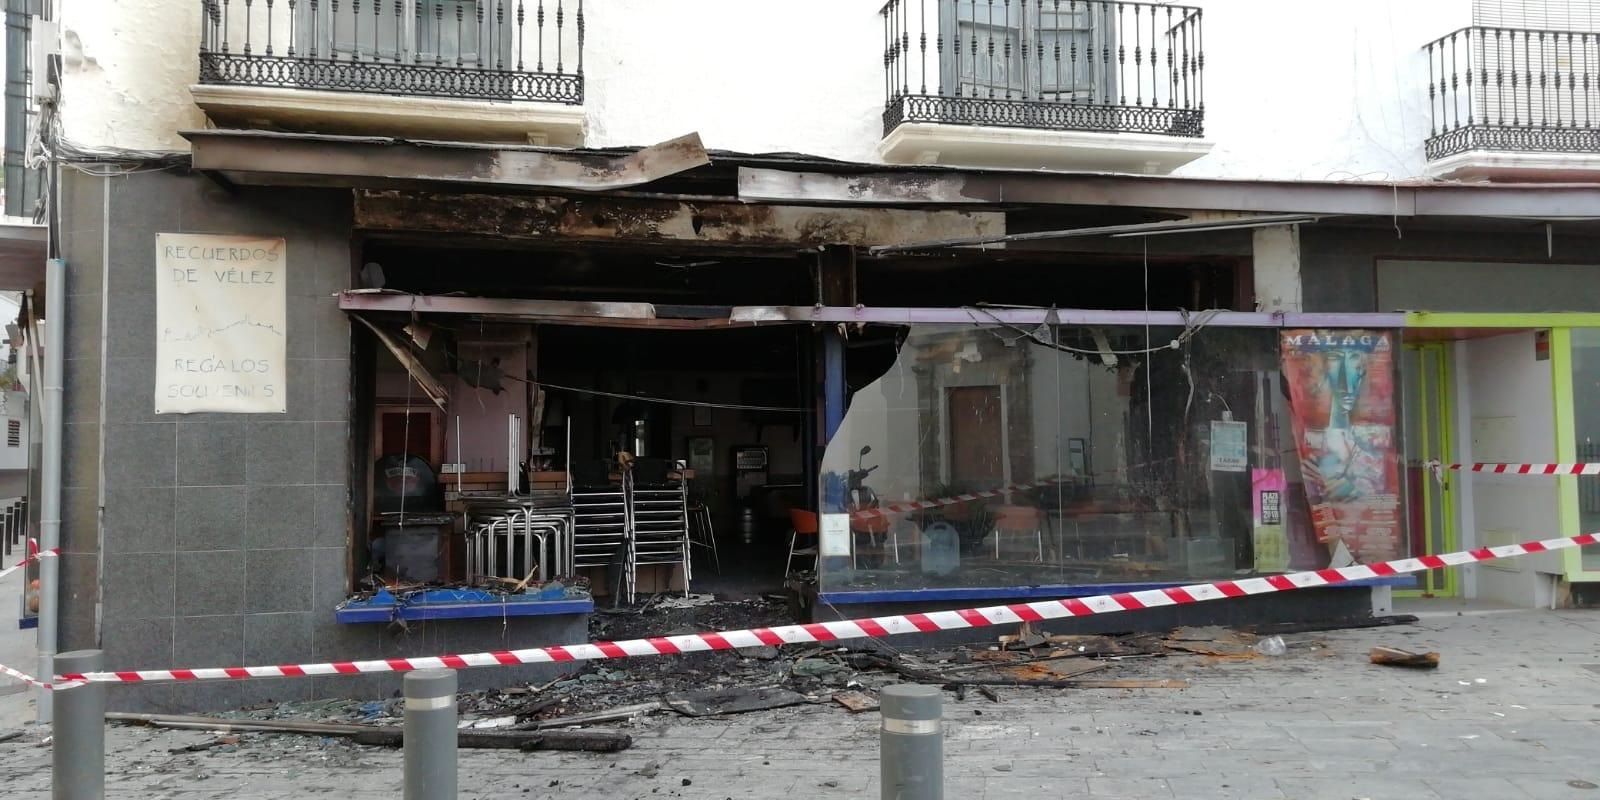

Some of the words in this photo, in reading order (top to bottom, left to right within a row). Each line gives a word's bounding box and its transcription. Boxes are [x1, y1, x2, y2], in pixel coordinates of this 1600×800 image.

[165, 246, 279, 262] RECUERDOS
[173, 268, 198, 282] DE
[214, 267, 275, 284] VÉLEZ
[174, 358, 270, 373] REGALOS
